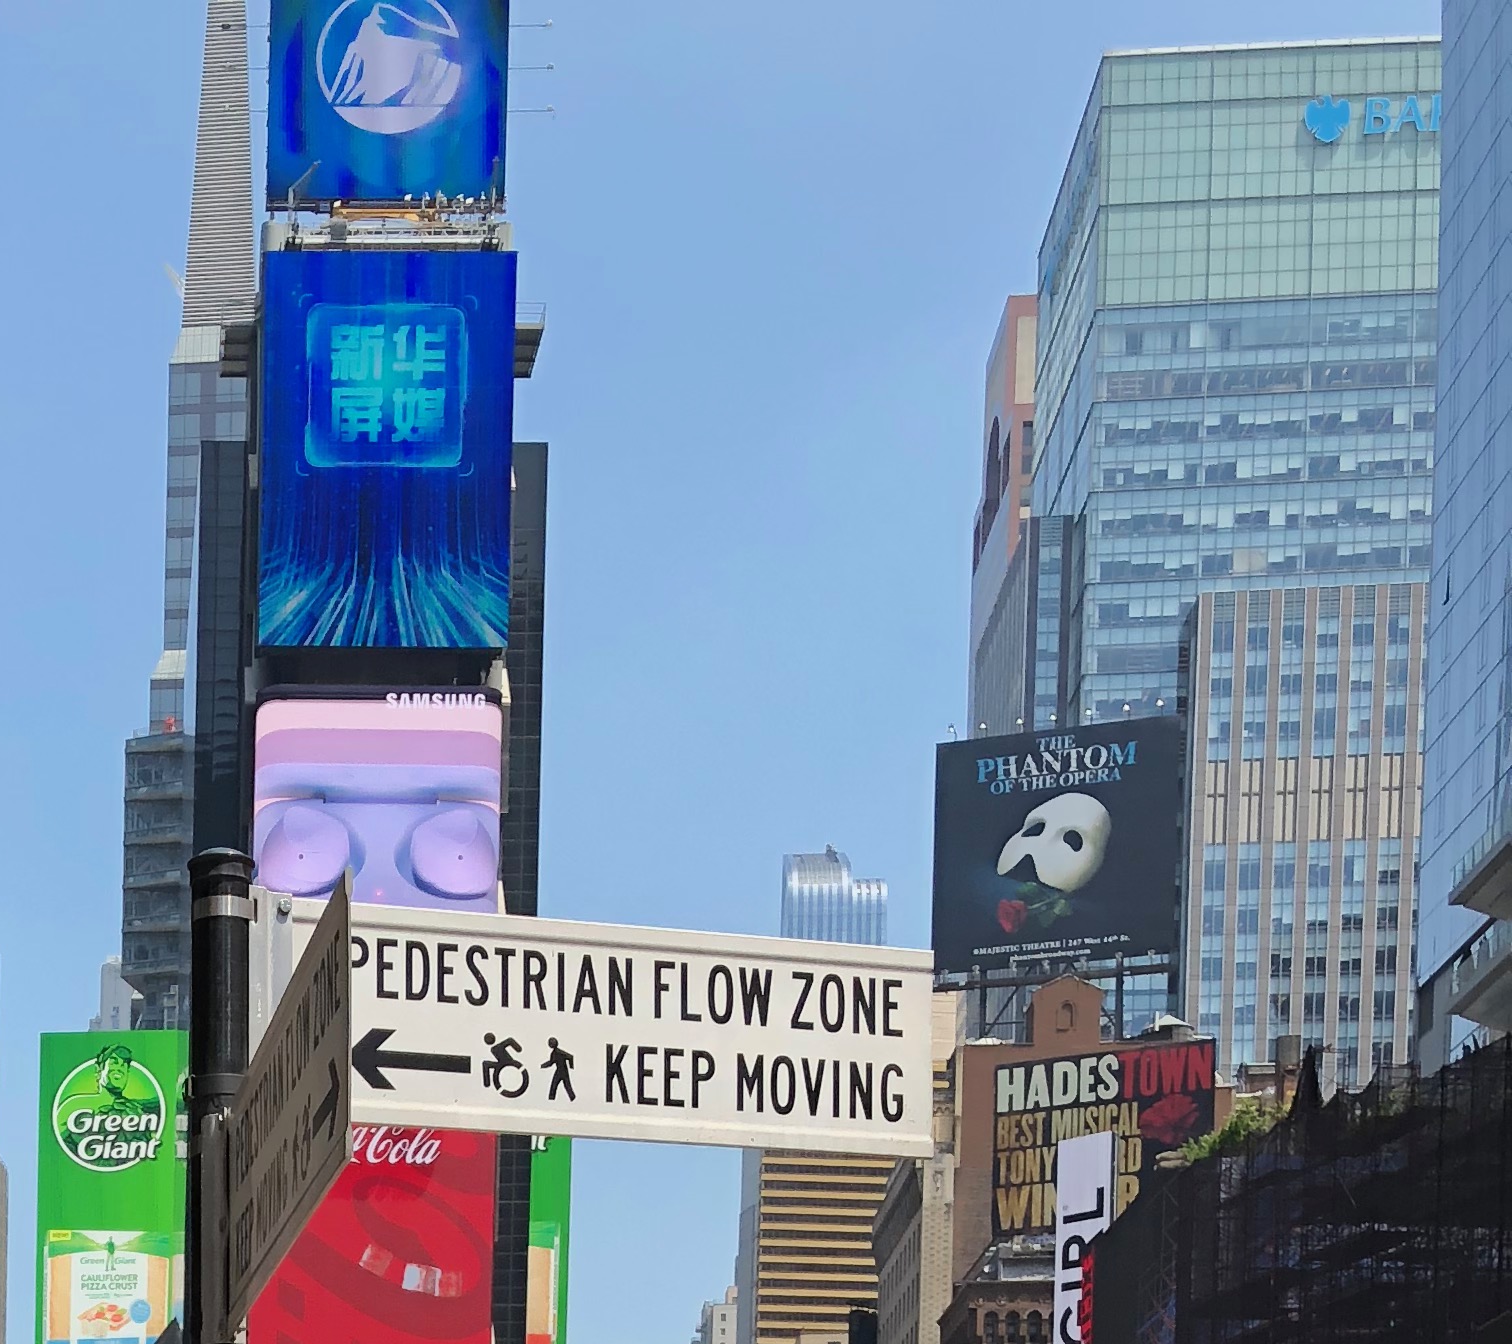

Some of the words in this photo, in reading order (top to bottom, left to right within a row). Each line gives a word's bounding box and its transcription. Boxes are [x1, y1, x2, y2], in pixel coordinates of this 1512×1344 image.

[331, 324, 446, 380] 新华
[386, 693, 486, 710] SAMSUNG
[1036, 734, 1075, 750] THE
[976, 741, 1137, 783] PHANTOM
[990, 779, 1014, 794] OF
[1018, 774, 1057, 791] THE
[1059, 767, 1122, 787] OPERA
[1022, 941, 1061, 950] THEATRE
[351, 936, 633, 1018] PEDESTRIAN
[654, 961, 772, 1026] FLOW
[790, 971, 903, 1037] ZONE
[235, 1038, 285, 1193] PEDESTRIAN
[287, 989, 312, 1092] FLOW
[313, 929, 342, 1052] ZONE
[605, 1043, 716, 1109] KEEP
[737, 1054, 904, 1122] MOVING
[997, 1043, 1213, 1113] HADESTOWN
[67, 1109, 158, 1134] Green
[997, 1112, 1046, 1149] BEST
[1051, 1101, 1141, 1143] MUSICAL
[77, 1133, 162, 1160] Giant
[997, 1146, 1057, 1186] TONY
[256, 1142, 288, 1254] MOVING
[80, 1257, 105, 1266] Green
[114, 1256, 136, 1265] Giant
[80, 1273, 139, 1283] CAULIFLOWER
[80, 1282, 106, 1291] PIZZA
[108, 1281, 138, 1291] CRUST
